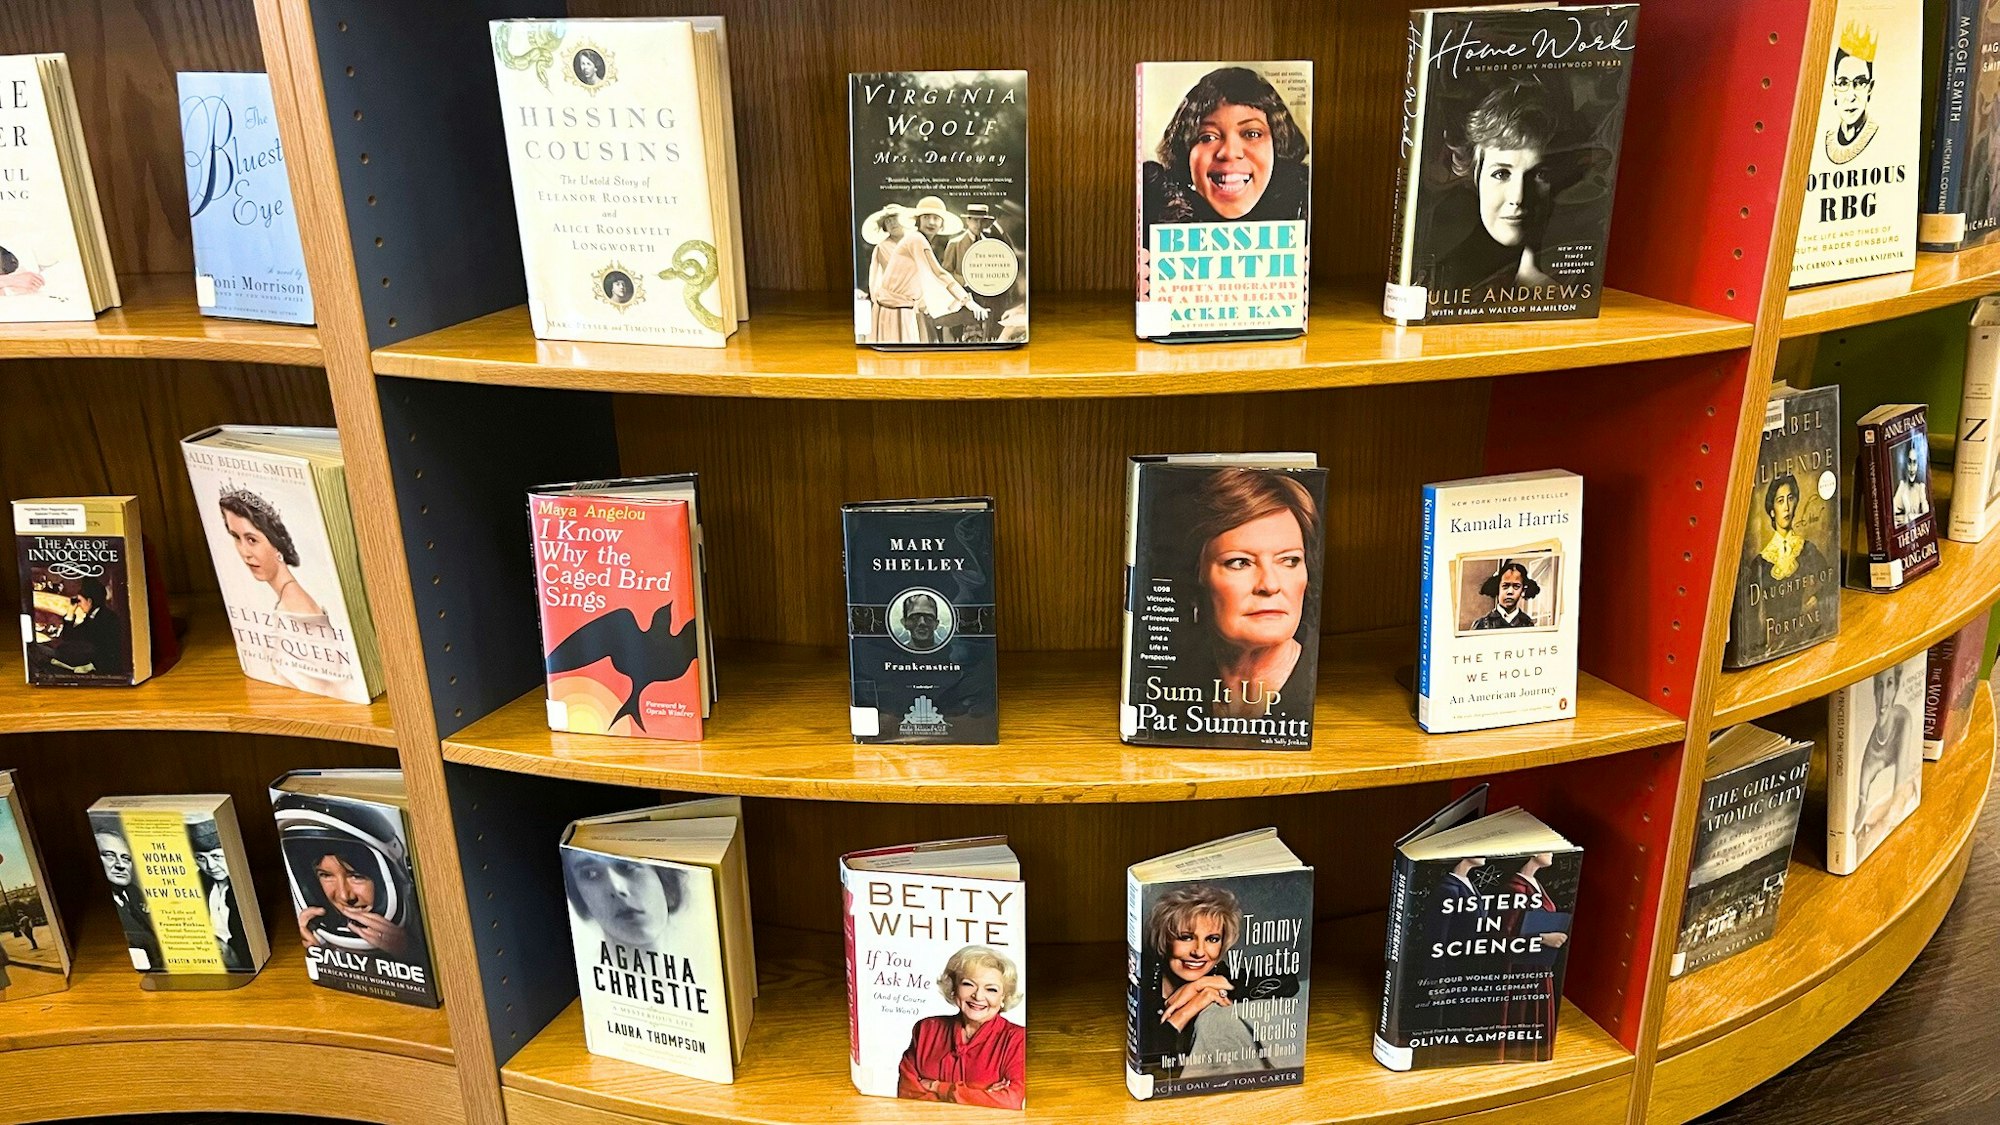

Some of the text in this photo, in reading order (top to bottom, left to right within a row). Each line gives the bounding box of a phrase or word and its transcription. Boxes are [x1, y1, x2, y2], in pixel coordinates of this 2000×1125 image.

[1428, 17, 1636, 79] Home Work
[1465, 59, 1623, 73] A MEMOIR OF MY HOLLYWOOD YEARS
[1950, 16, 1971, 122] MAGGIE SMITH
[864, 84, 1016, 105] VIRGINIA
[245, 106, 268, 129] The
[519, 106, 676, 130] HISSING
[887, 113, 997, 137] WOOLF
[525, 140, 681, 162] COUSINS
[873, 150, 1007, 167] Mrs. Dalloway
[560, 174, 651, 189] The Untold Story of
[1806, 164, 1906, 192] OTORIOUS
[233, 179, 284, 227] Eye
[538, 190, 679, 206] ELEANOR ROOSEVELT
[1819, 192, 1877, 224] RBG
[552, 222, 672, 237] ALICE ROOSEVELT
[1156, 225, 1297, 253] BESSIE
[572, 240, 656, 254] LONGWORTH
[1157, 254, 1298, 281] SMITH
[203, 274, 304, 295] oni Morrison
[1428, 283, 1593, 306] ULIE ANDREWS
[1171, 304, 1296, 321] ACKIE KAY
[1431, 303, 1577, 317] WITH EMMA WALTON HAMILTON
[1962, 418, 1988, 442] Z
[188, 451, 214, 466] ALLY
[218, 456, 261, 473] BEDELL
[263, 463, 304, 480] SMITH
[1759, 448, 1833, 483] LLENDE
[1520, 492, 1569, 501] BESTSELLER
[538, 501, 646, 523] Maya Angelou
[1450, 509, 1570, 534] Kamala Harris
[539, 518, 624, 543] I Know
[1422, 498, 1433, 580] Kamala Harris
[34, 536, 109, 550] THE AGE OF
[539, 541, 631, 568] Why the
[890, 538, 946, 551] MARY
[28, 549, 119, 563] INNOCENCE
[872, 558, 966, 572] SHELLEY
[1901, 550, 1921, 571] OUNG
[1921, 541, 1937, 559] GIRL
[542, 564, 672, 592] Caged Bird
[1750, 568, 1834, 607] DAUGHTER OF
[545, 586, 607, 614] Sings
[1146, 595, 1176, 604] Victories,
[229, 605, 346, 642] ELIZABETH
[1147, 624, 1172, 633] Losses,
[1765, 610, 1821, 642] FORTUNE
[234, 628, 352, 666] THE QUEEN
[1140, 652, 1177, 662] Perspective
[1452, 645, 1559, 665] THE TRUTHS
[884, 661, 961, 671] Frankenstein
[1466, 666, 1543, 683] WE HOLD
[1146, 676, 1281, 716] Sum It Up
[1449, 686, 1558, 705] An American Journey
[1137, 703, 1309, 738] Pat Summitt
[1707, 761, 1810, 812] THE GIRLS OF
[1768, 783, 1805, 809] CITY
[142, 852, 183, 863] WOMAN
[151, 842, 167, 851] THE
[146, 866, 186, 876] BEHIND
[162, 878, 177, 886] THE
[145, 888, 202, 899] NEW DEAL
[869, 881, 1013, 915] BETTY
[1396, 873, 1407, 910] SISTERS
[1441, 892, 1543, 914] SISTERS
[1395, 910, 1403, 921] IN
[1476, 916, 1502, 933] IN
[868, 912, 1009, 946] WHITE
[1243, 913, 1303, 950] Tammy
[1391, 921, 1402, 964] SCIENCE
[1431, 936, 1543, 959] SCIENCE
[308, 946, 426, 984] SALLY RIDE
[600, 940, 696, 985] AGATHA
[866, 950, 912, 971] If You
[1227, 947, 1300, 987] Wynette
[874, 971, 931, 990] Ask Me
[1428, 982, 1540, 996] ESCAPED NAZI GERMANY
[1439, 975, 1463, 985] FOUR
[1465, 974, 1500, 982] WOMEN
[1502, 971, 1555, 981] PHYSICISTS
[347, 982, 396, 998] LYNN SHERR
[593, 965, 709, 1015] CHRISTIE
[1432, 998, 1457, 1007] MADE
[1459, 995, 1510, 1004] SCIENTIFIC
[1512, 993, 1551, 1001] HISTORY
[1230, 995, 1299, 1023] A Daughter
[607, 1020, 643, 1040] LAURA
[646, 1029, 706, 1054] THOMPSON
[1253, 1018, 1298, 1042] Recalls
[1409, 1030, 1543, 1048] OLIVIA CAMPBELL
[1161, 1042, 1297, 1069] Her Mother's Tragic Life and Death
